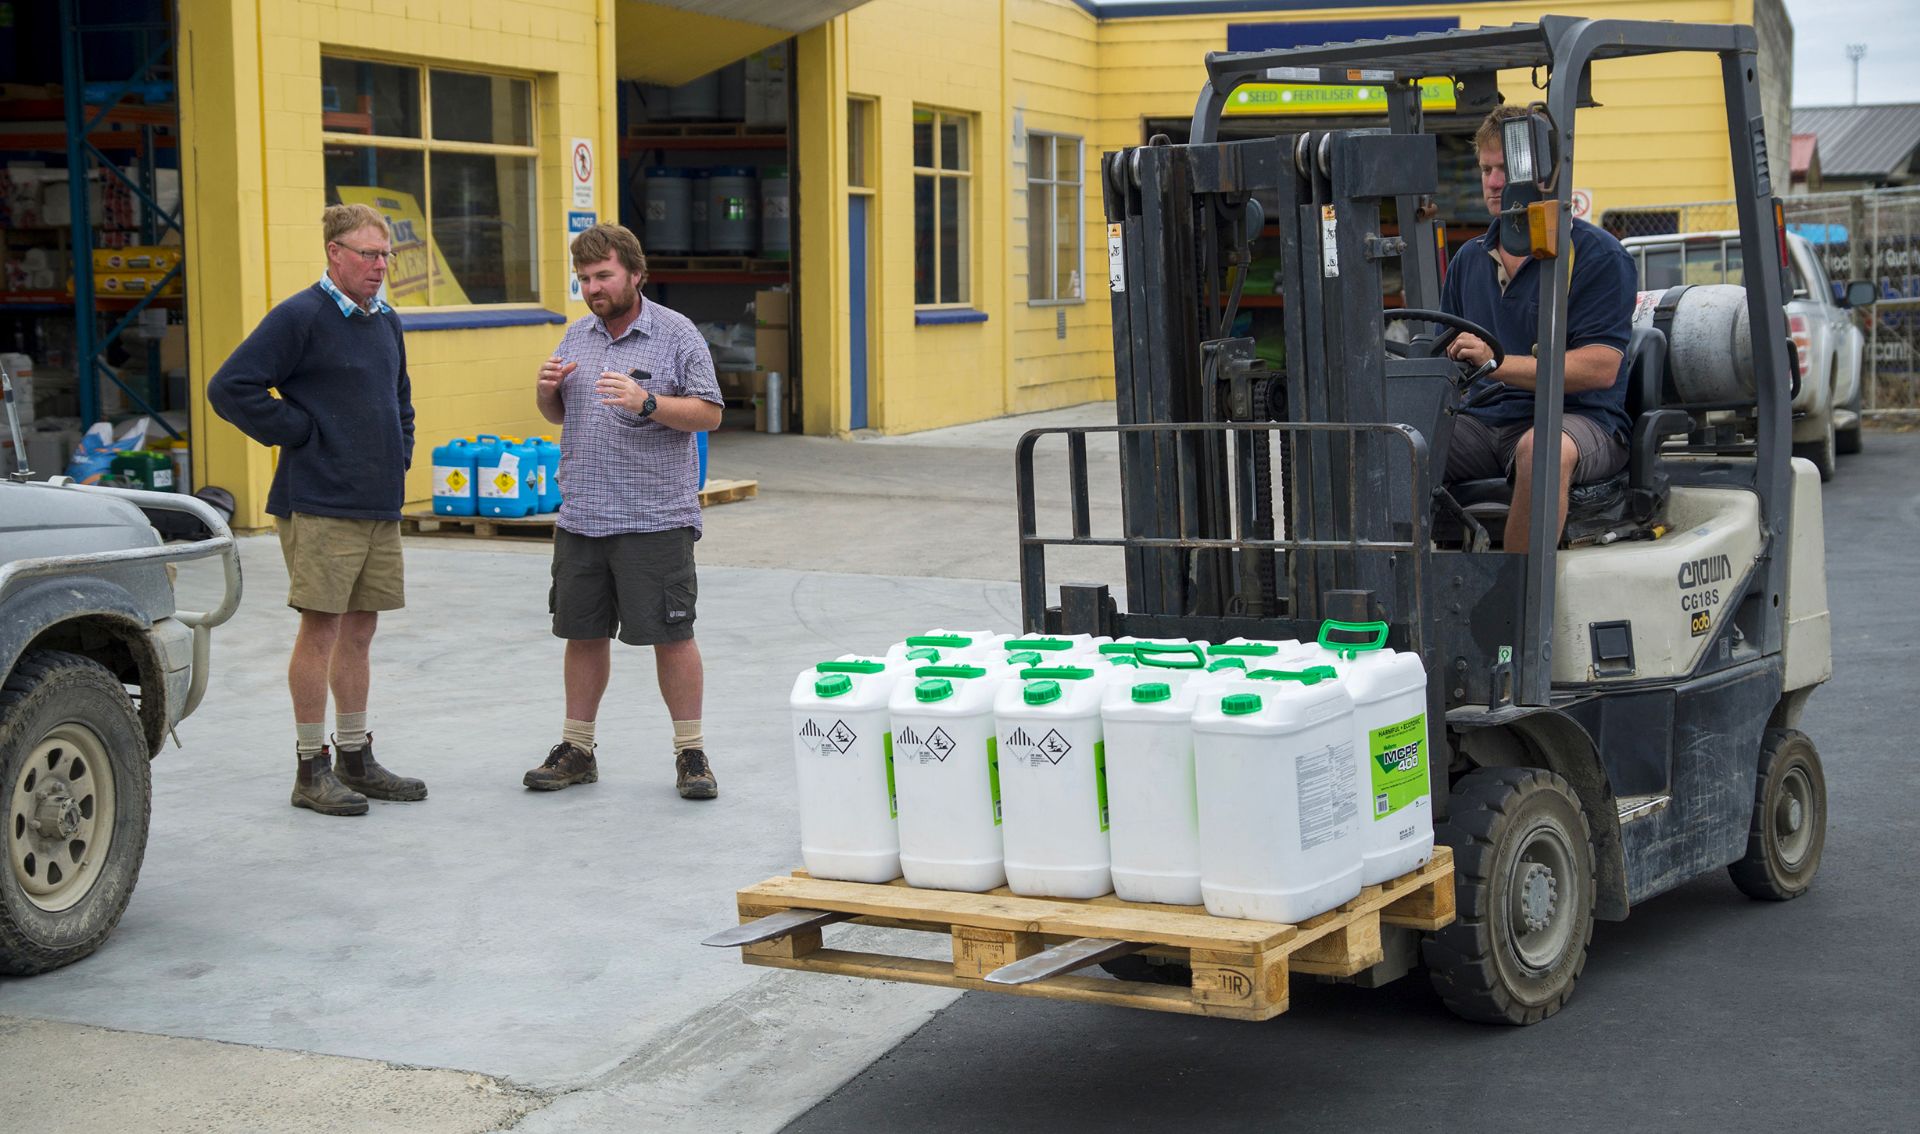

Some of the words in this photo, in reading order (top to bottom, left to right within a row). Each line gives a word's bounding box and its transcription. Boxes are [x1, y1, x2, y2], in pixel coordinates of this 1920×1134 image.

[1249, 90, 1278, 102] SEED
[1294, 89, 1354, 101] FERTILISER
[1369, 85, 1440, 100] CHALS
[1678, 554, 1731, 589] CROWN
[1682, 589, 1719, 611] CG18S
[1384, 742, 1418, 764] MCPB
[1398, 755, 1418, 771] 400
